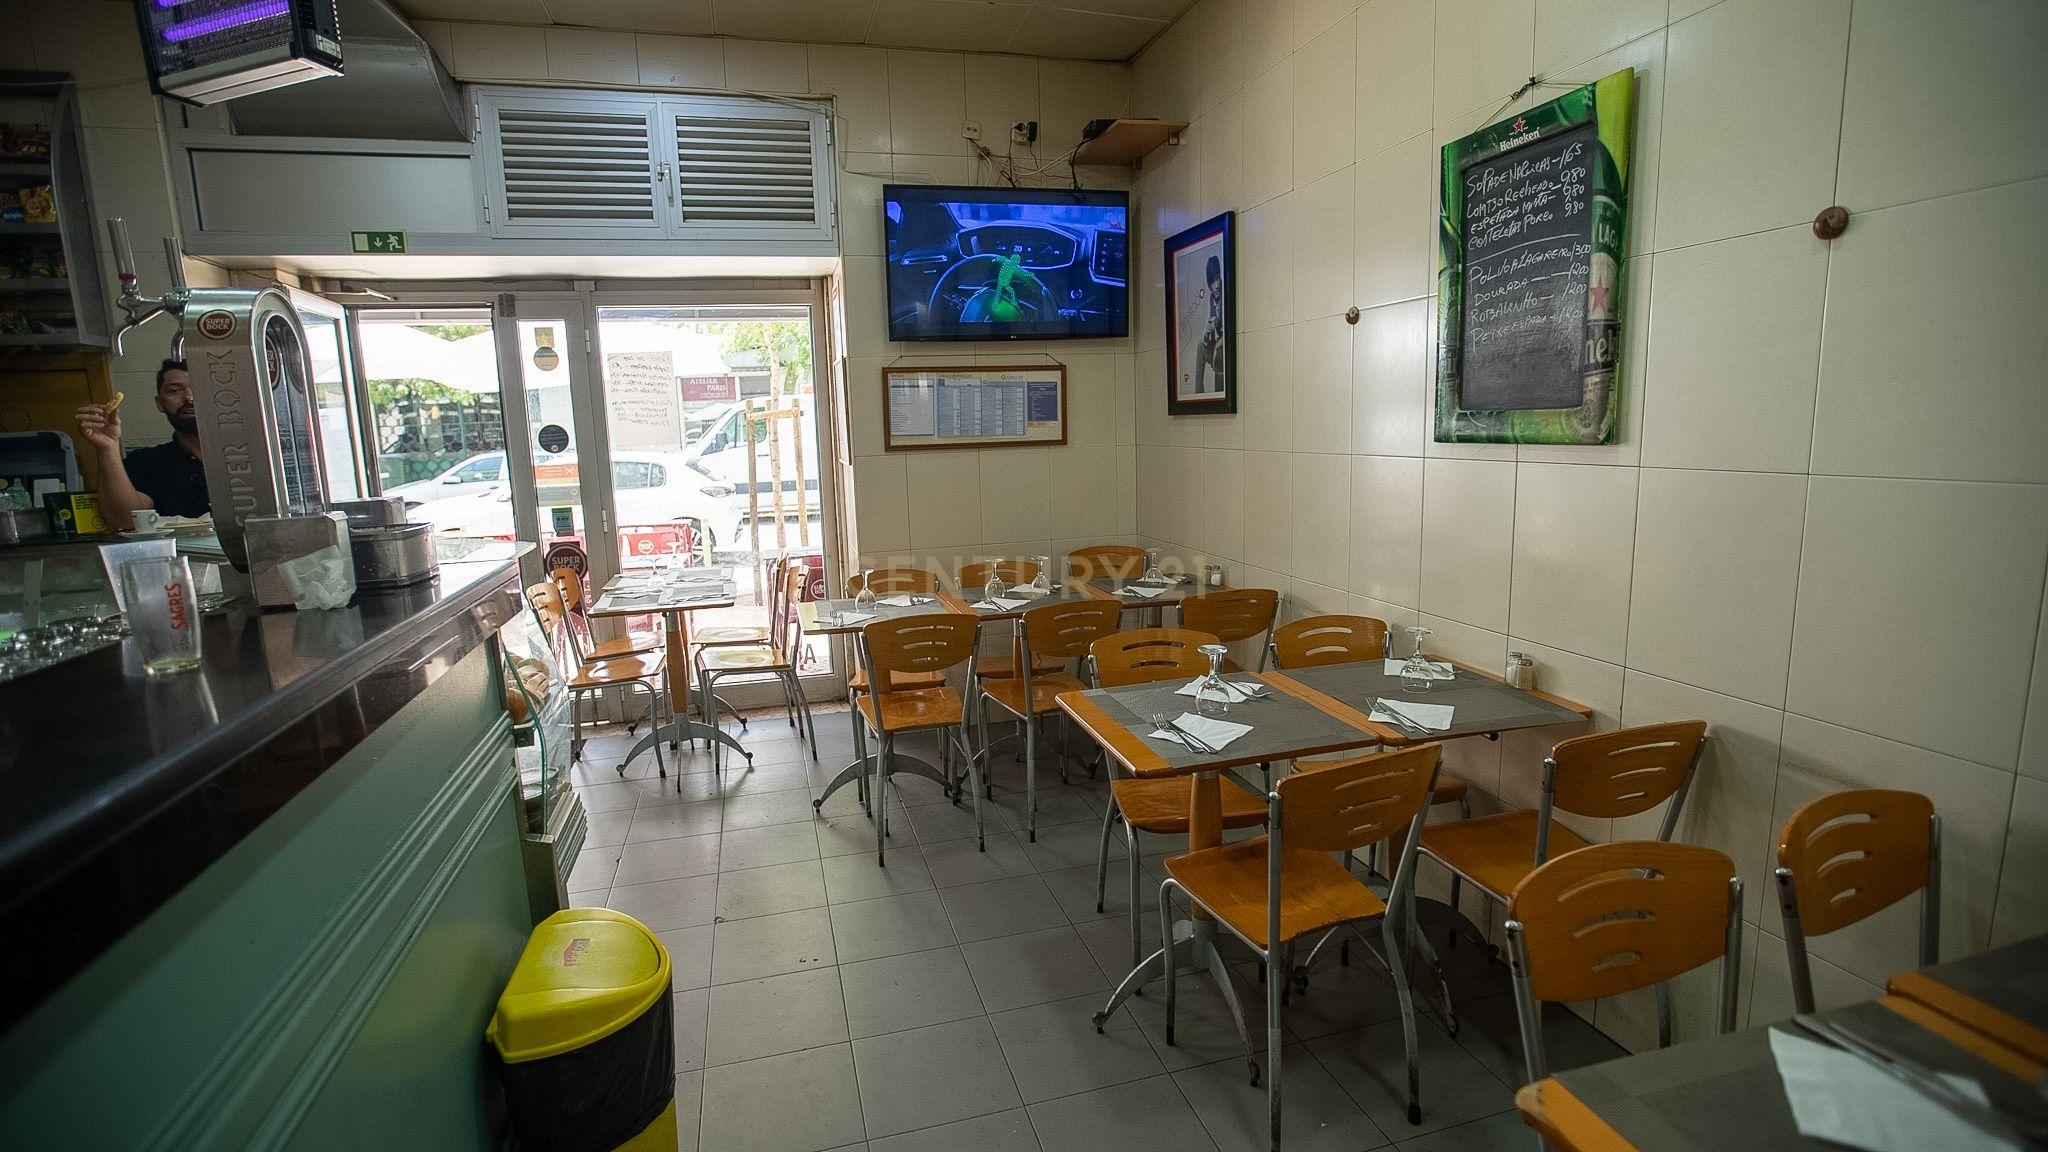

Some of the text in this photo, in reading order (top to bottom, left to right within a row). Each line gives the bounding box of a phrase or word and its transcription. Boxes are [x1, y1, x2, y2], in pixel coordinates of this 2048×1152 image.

[1500, 130, 1541, 152] Heineken
[205, 317, 231, 325] SUPER
[207, 349, 245, 428] BOCK
[551, 555, 581, 566] SUPER
[165, 582, 189, 631] SAGRES
